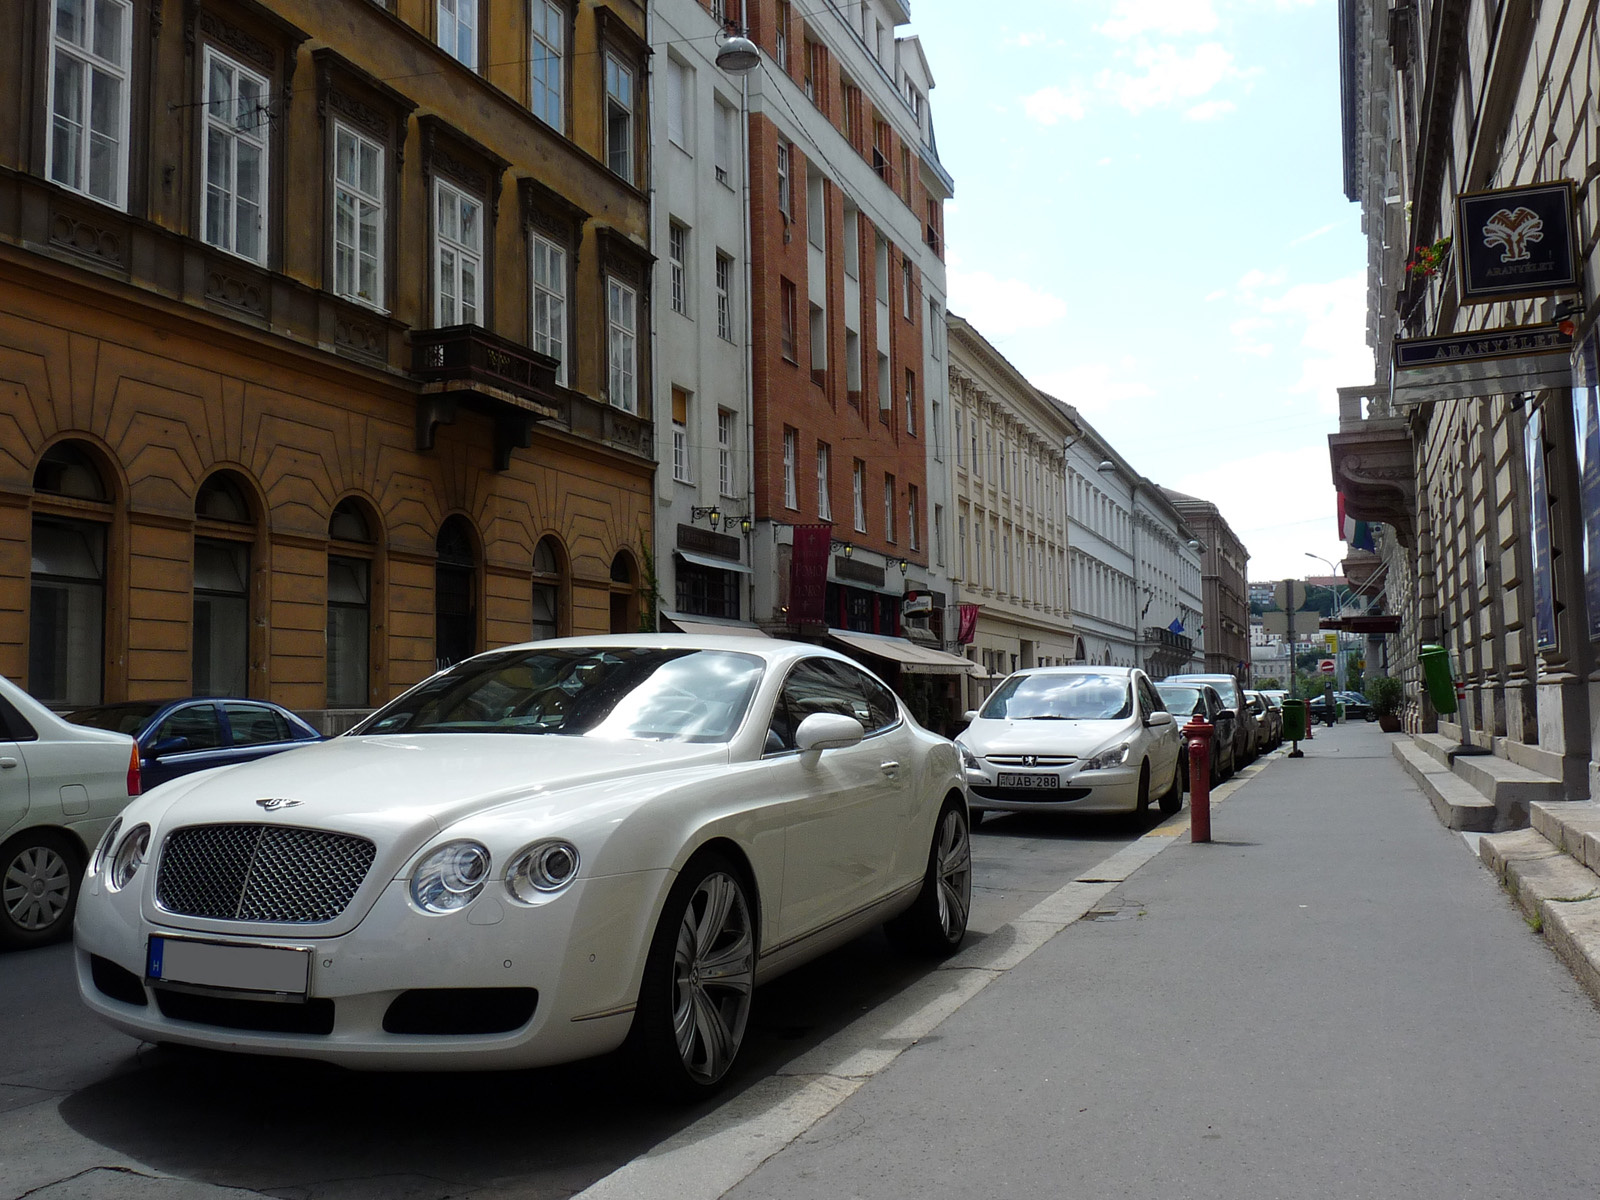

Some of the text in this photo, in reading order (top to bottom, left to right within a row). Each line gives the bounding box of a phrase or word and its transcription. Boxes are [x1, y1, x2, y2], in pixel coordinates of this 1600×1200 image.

[1486, 262, 1555, 276] ARANYÉLET
[1434, 333, 1560, 359] ARANYÉLET
[1008, 776, 1056, 787] JAB-288
[153, 960, 160, 972] H
